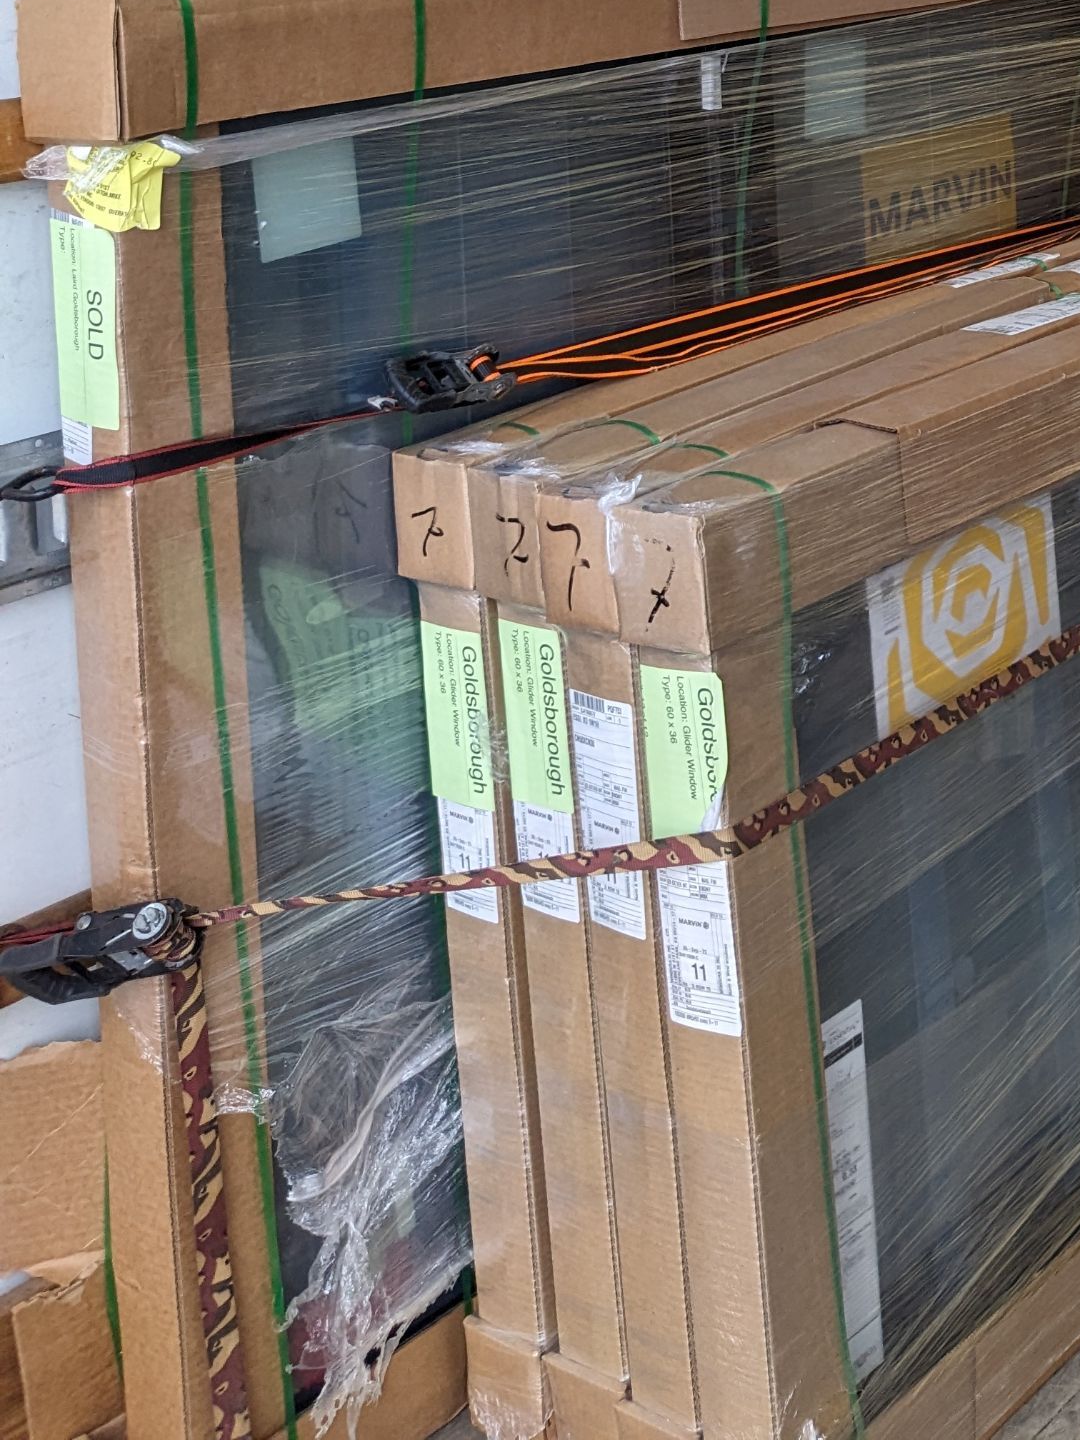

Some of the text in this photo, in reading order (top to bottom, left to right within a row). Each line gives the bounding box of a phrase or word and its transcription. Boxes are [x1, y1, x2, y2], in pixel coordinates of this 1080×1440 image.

[868, 159, 1012, 237] MARVIN
[57, 227, 66, 253] Type:
[86, 289, 104, 360] SOLD
[433, 631, 442, 656] Type:
[438, 659, 445, 672] 60
[511, 628, 519, 655] Type:
[515, 657, 522, 670] 60
[446, 633, 461, 747] Location: Glider Window
[523, 630, 538, 747] Location: Glider Window
[661, 674, 671, 703] Type:
[462, 645, 488, 794] Goldsborough
[539, 643, 566, 796] Goldsborough
[666, 706, 675, 719] 60
[670, 730, 678, 744] 36
[676, 675, 698, 800] Location: Glider Window
[593, 820, 614, 833] MARVIN
[459, 852, 471, 872] 11
[678, 918, 703, 928] MARVIN
[691, 962, 707, 981] 11
